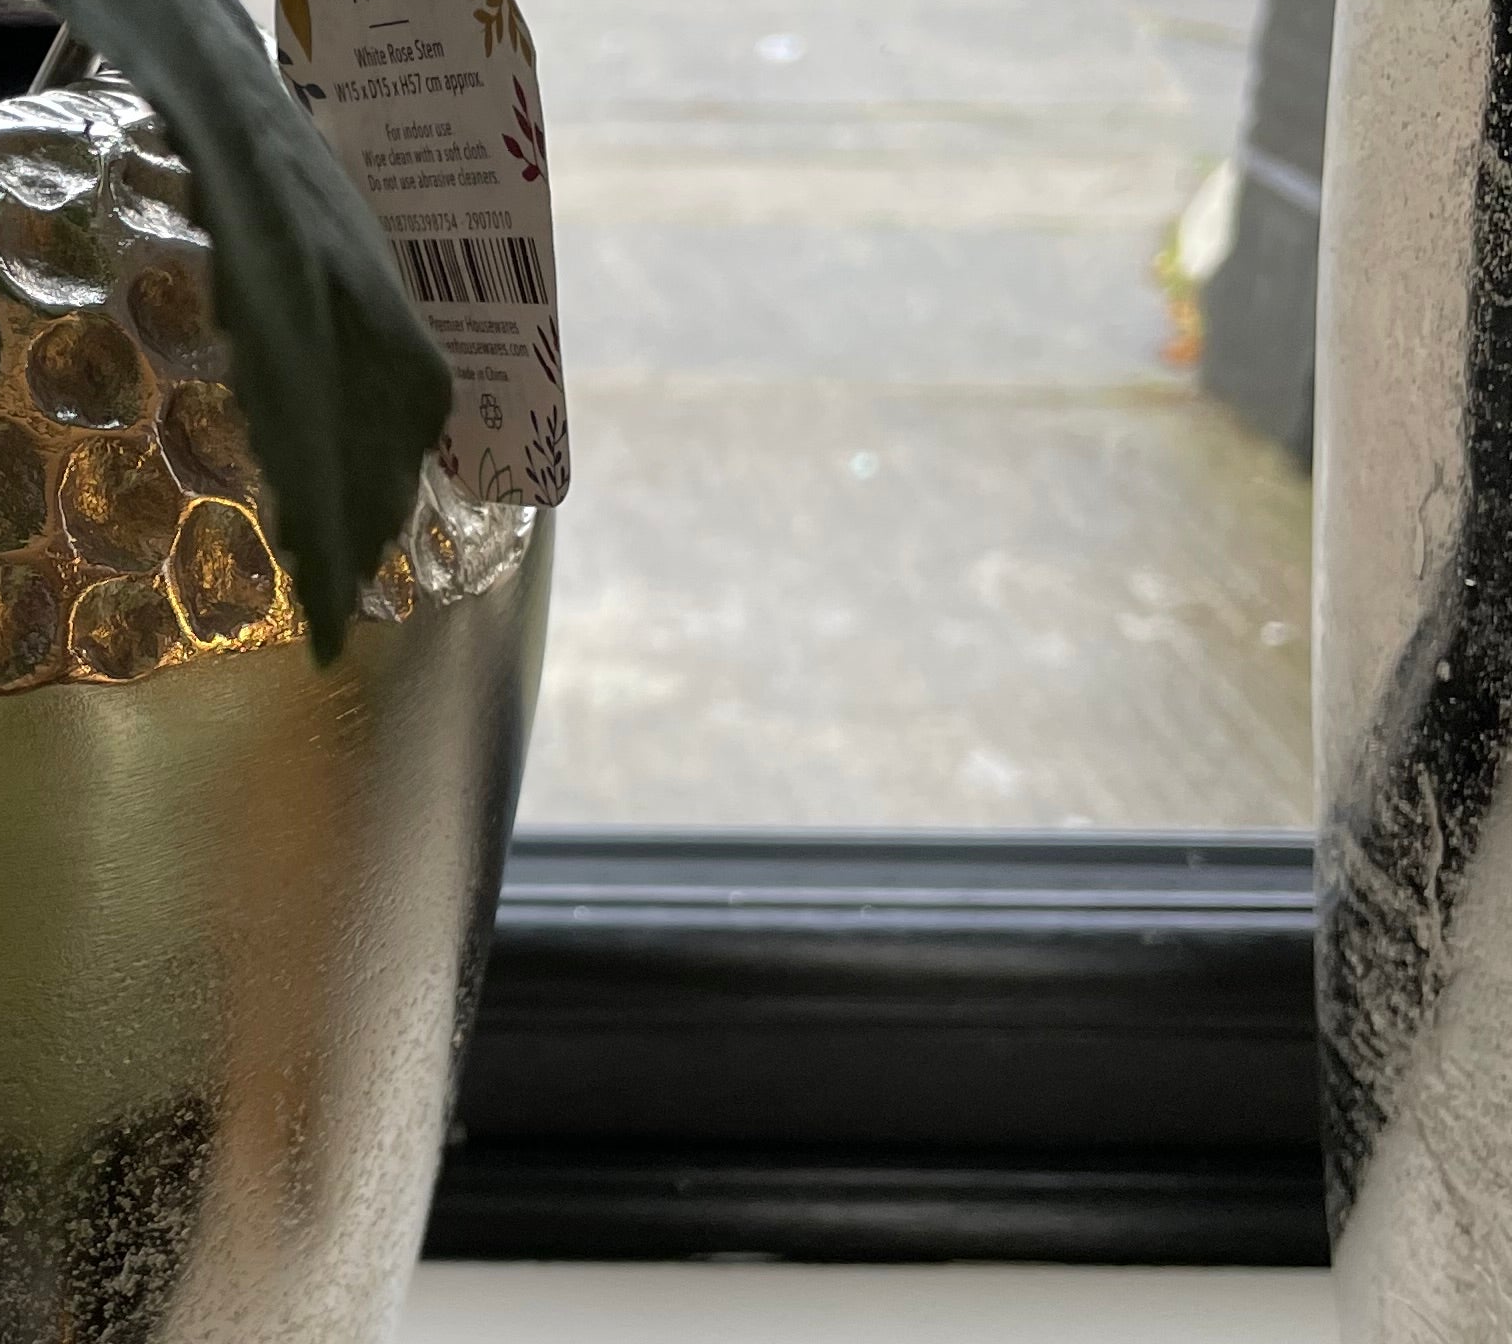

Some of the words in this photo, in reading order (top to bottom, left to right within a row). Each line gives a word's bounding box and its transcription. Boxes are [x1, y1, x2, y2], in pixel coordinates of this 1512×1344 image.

[356, 47, 387, 68] White
[387, 43, 415, 64] Rose
[415, 39, 446, 60] Stem
[368, 77, 391, 99] D15
[399, 73, 423, 95] H57
[425, 76, 442, 93] cm
[385, 123, 401, 141] For
[361, 148, 386, 171] Wipe
[388, 147, 413, 166] clean
[414, 144, 435, 163] with
[444, 141, 462, 161] soft
[367, 174, 382, 192] Do
[383, 174, 399, 191] not
[399, 174, 417, 190] use
[418, 169, 456, 189] abrasive
